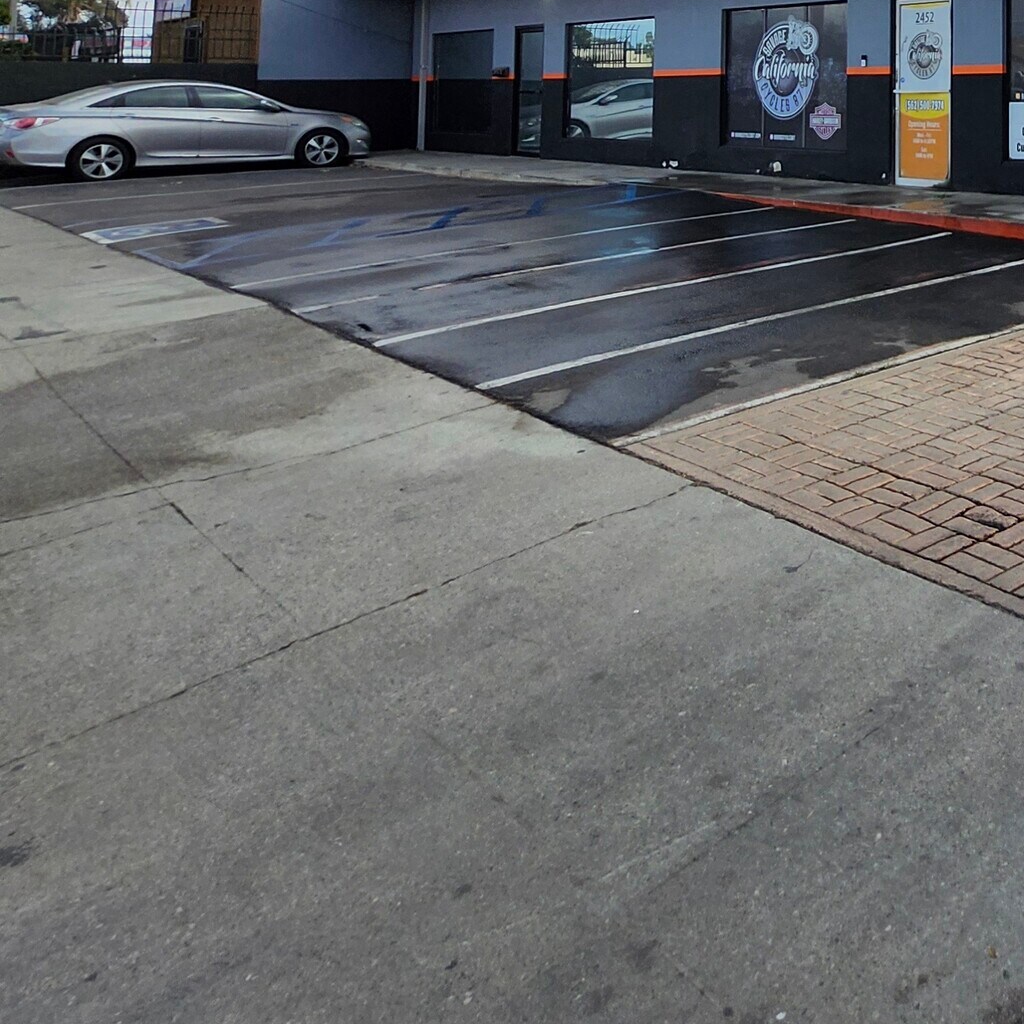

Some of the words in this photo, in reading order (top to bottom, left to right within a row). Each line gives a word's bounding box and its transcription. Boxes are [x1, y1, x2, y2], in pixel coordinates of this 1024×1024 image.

[915, 11, 935, 24] 2452
[762, 29, 787, 56] SAVAGE
[755, 49, 816, 88] California
[760, 82, 790, 112] CYCLES
[792, 87, 804, 107] 87
